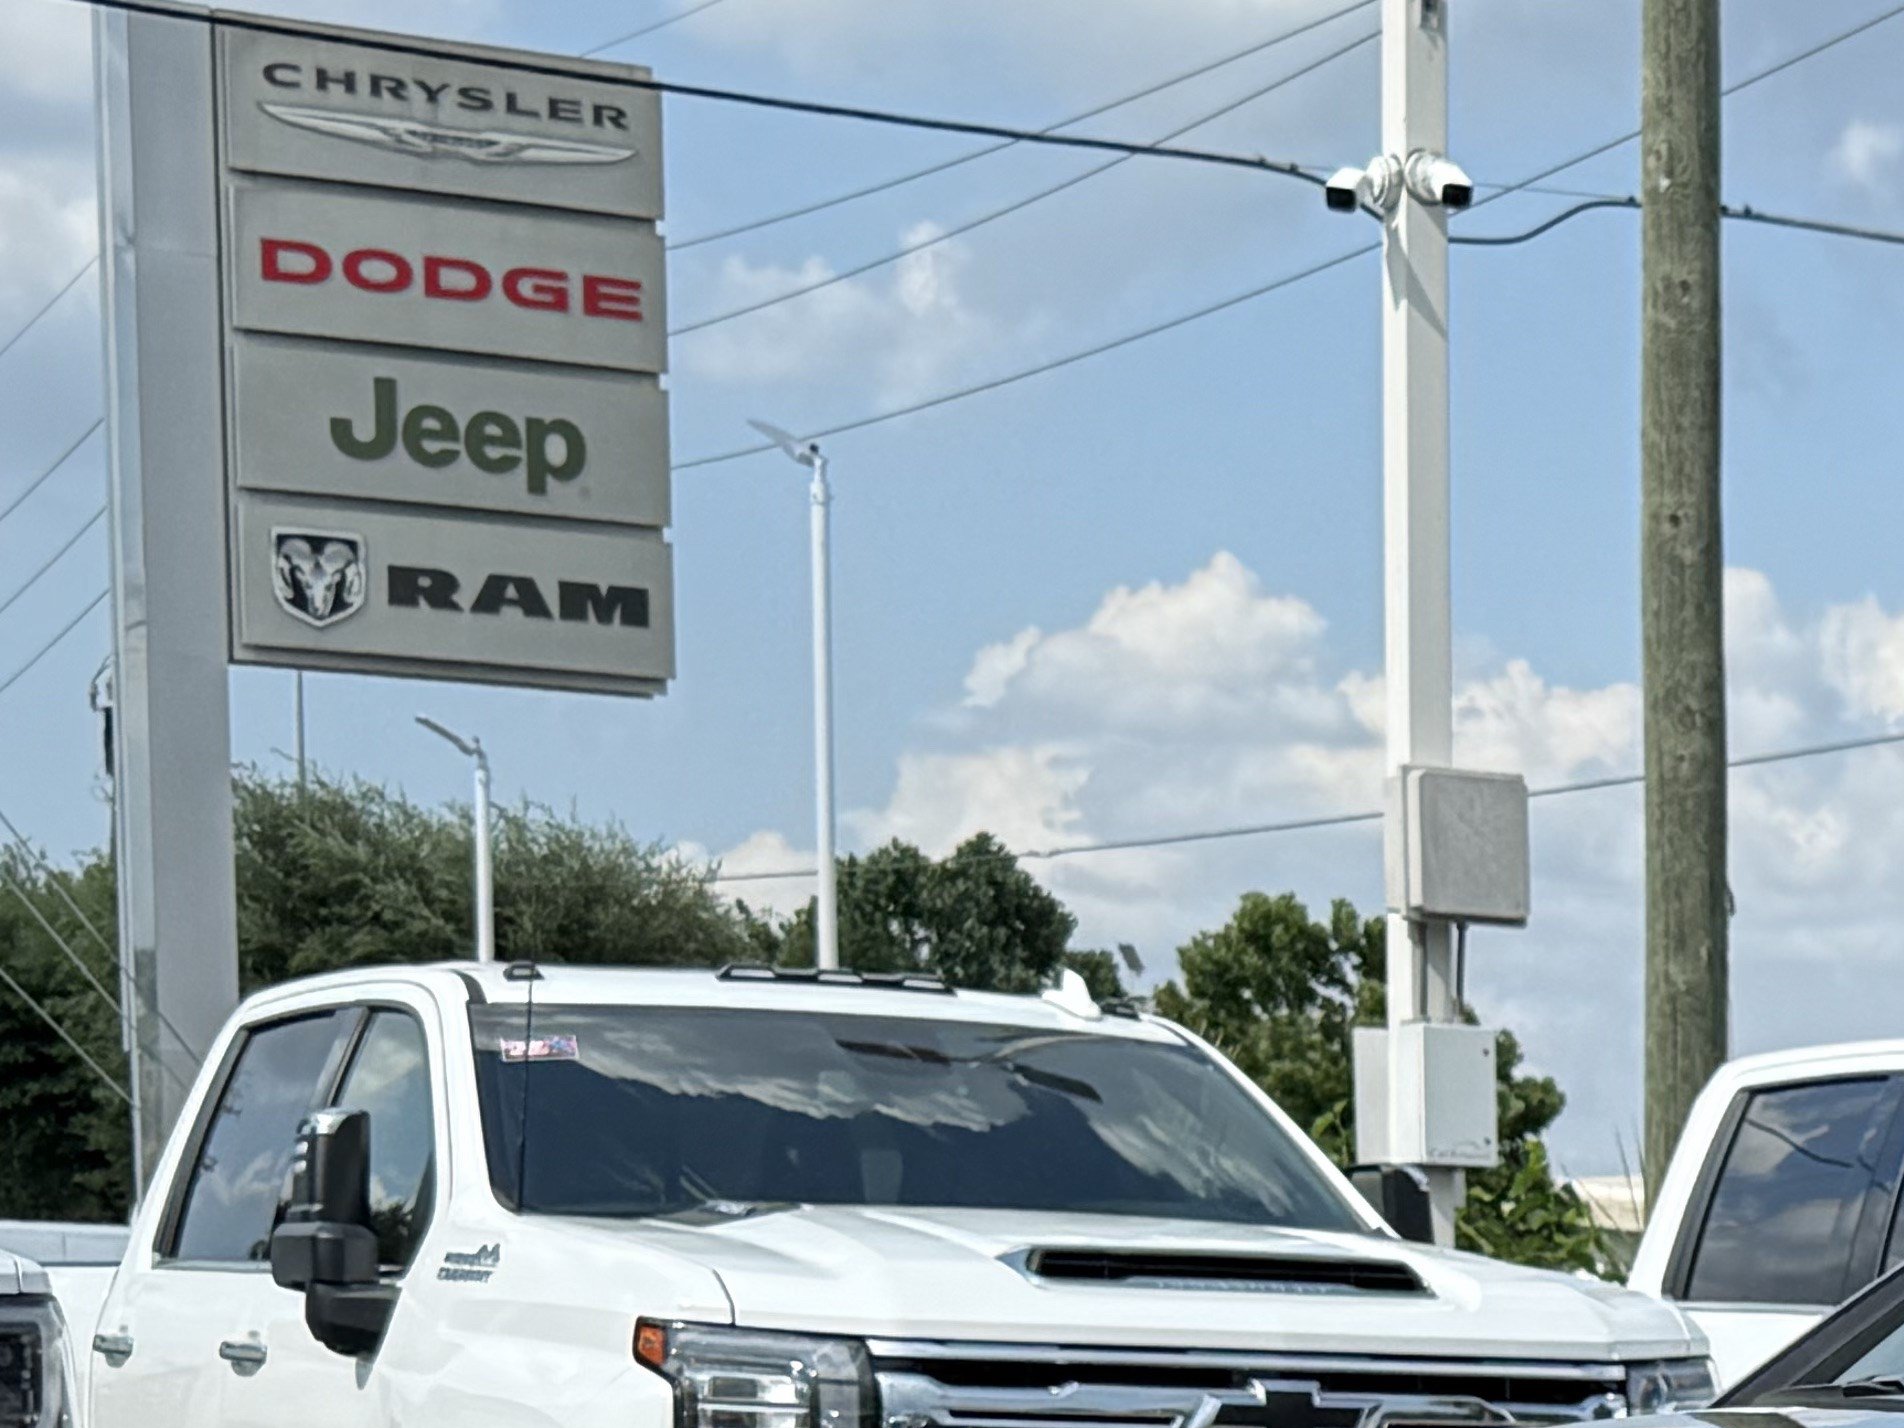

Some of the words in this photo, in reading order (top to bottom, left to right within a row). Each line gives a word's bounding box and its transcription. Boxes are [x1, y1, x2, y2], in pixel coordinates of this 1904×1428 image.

[262, 62, 630, 132] CHRYSLER
[260, 237, 643, 321] DODGE
[329, 376, 587, 496] Jeep
[387, 564, 650, 628] RAM
